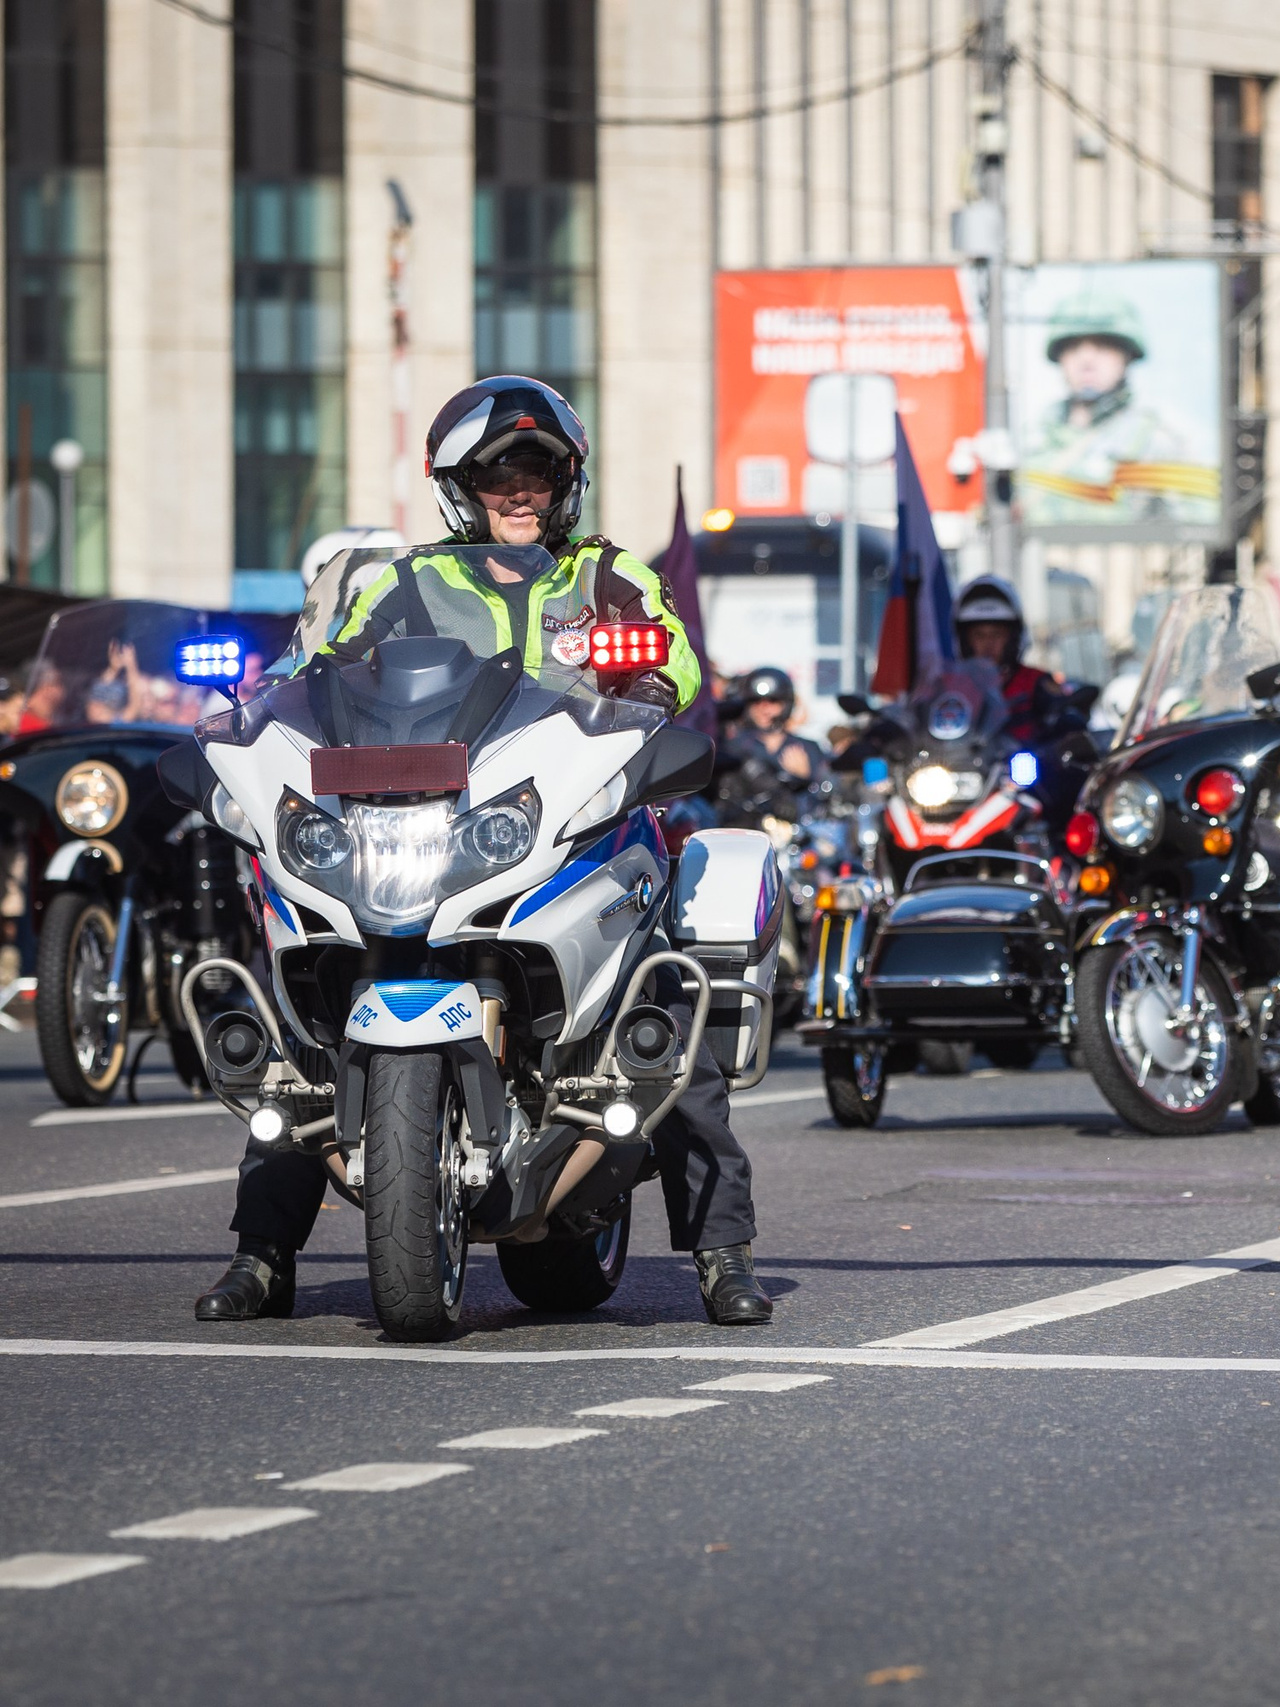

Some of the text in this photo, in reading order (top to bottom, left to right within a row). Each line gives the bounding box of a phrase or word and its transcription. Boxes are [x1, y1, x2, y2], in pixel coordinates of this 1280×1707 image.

[545, 618, 564, 630] ДПС
[350, 1004, 378, 1028] ДПС
[438, 1002, 472, 1032] ДПС
